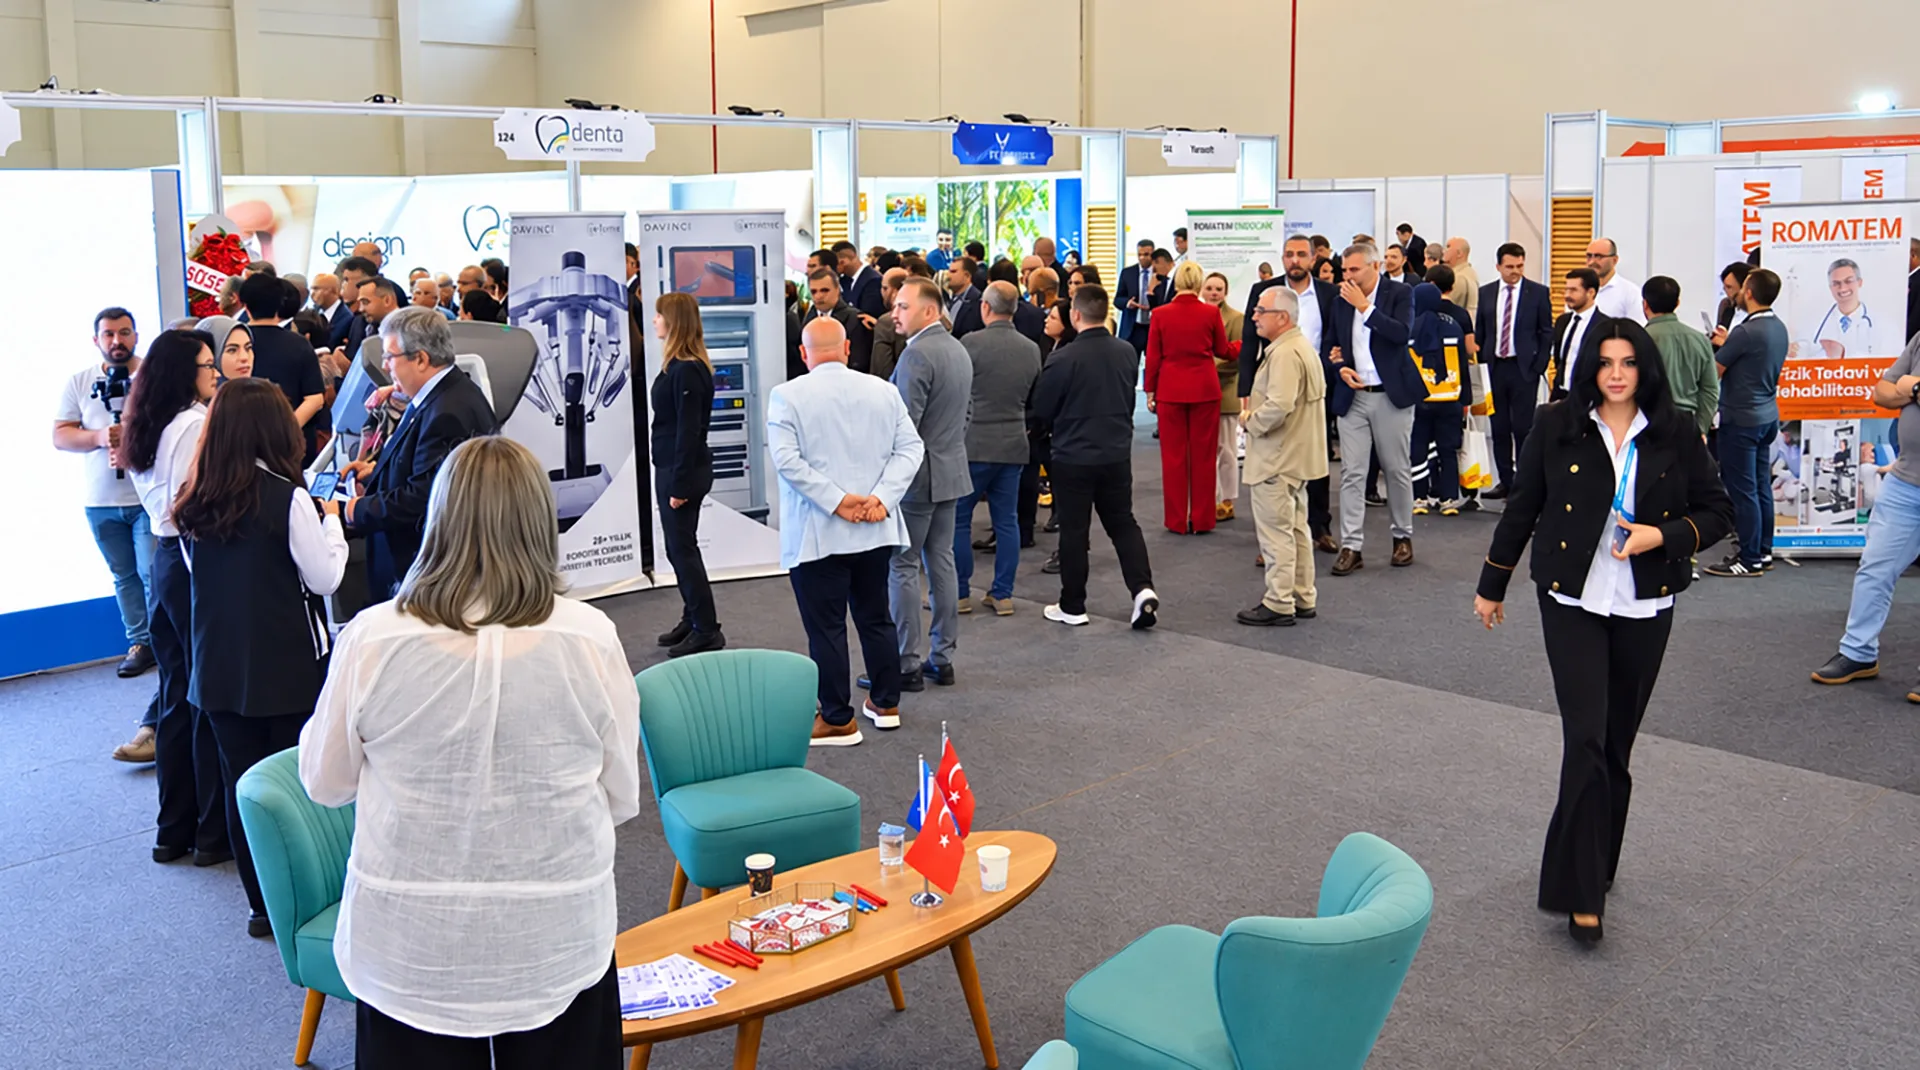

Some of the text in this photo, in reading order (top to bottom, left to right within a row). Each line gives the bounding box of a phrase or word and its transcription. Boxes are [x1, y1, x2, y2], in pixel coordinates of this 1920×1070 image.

[498, 133, 515, 142] 124
[572, 122, 623, 143] denta
[643, 222, 692, 232] DAVINCI
[323, 231, 405, 267] degn
[1815, 364, 1869, 380] Tedavi
